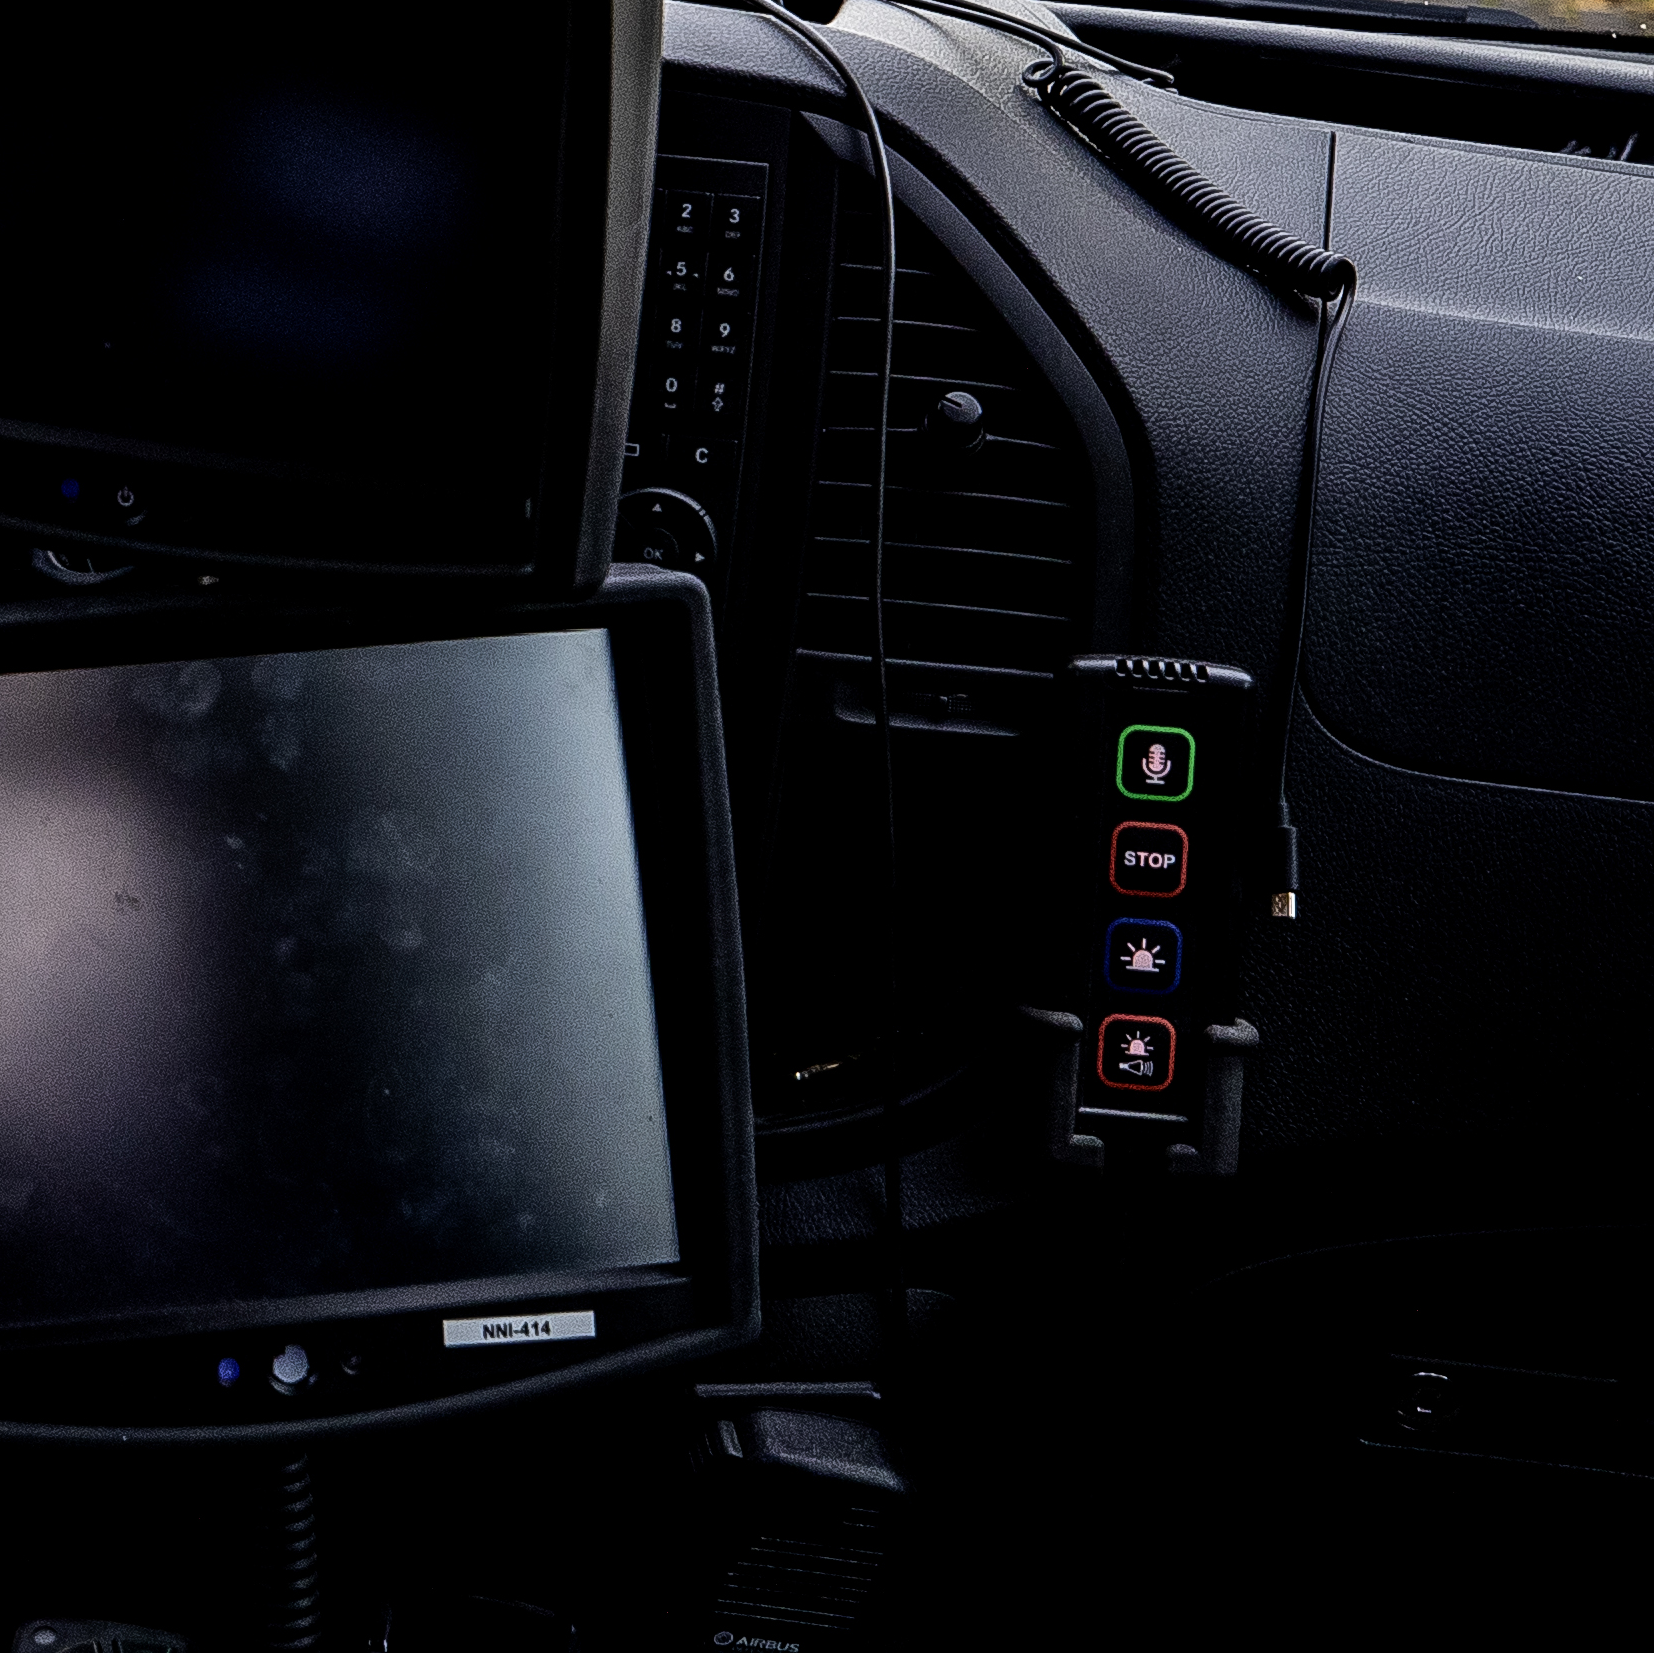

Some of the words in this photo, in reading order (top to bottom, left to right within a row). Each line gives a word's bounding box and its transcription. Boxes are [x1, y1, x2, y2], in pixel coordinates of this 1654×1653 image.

[680, 202, 693, 219] 2
[728, 207, 741, 224] 3
[675, 260, 688, 277] 5
[723, 266, 736, 283] 6
[670, 317, 683, 334] 8
[718, 322, 731, 338] 9
[664, 376, 679, 393] 0
[694, 447, 710, 464] C
[642, 545, 664, 561] OK
[1123, 850, 1176, 869] STOP
[482, 1320, 551, 1340] NNI-414
[735, 1636, 800, 1653] AIRBUS
